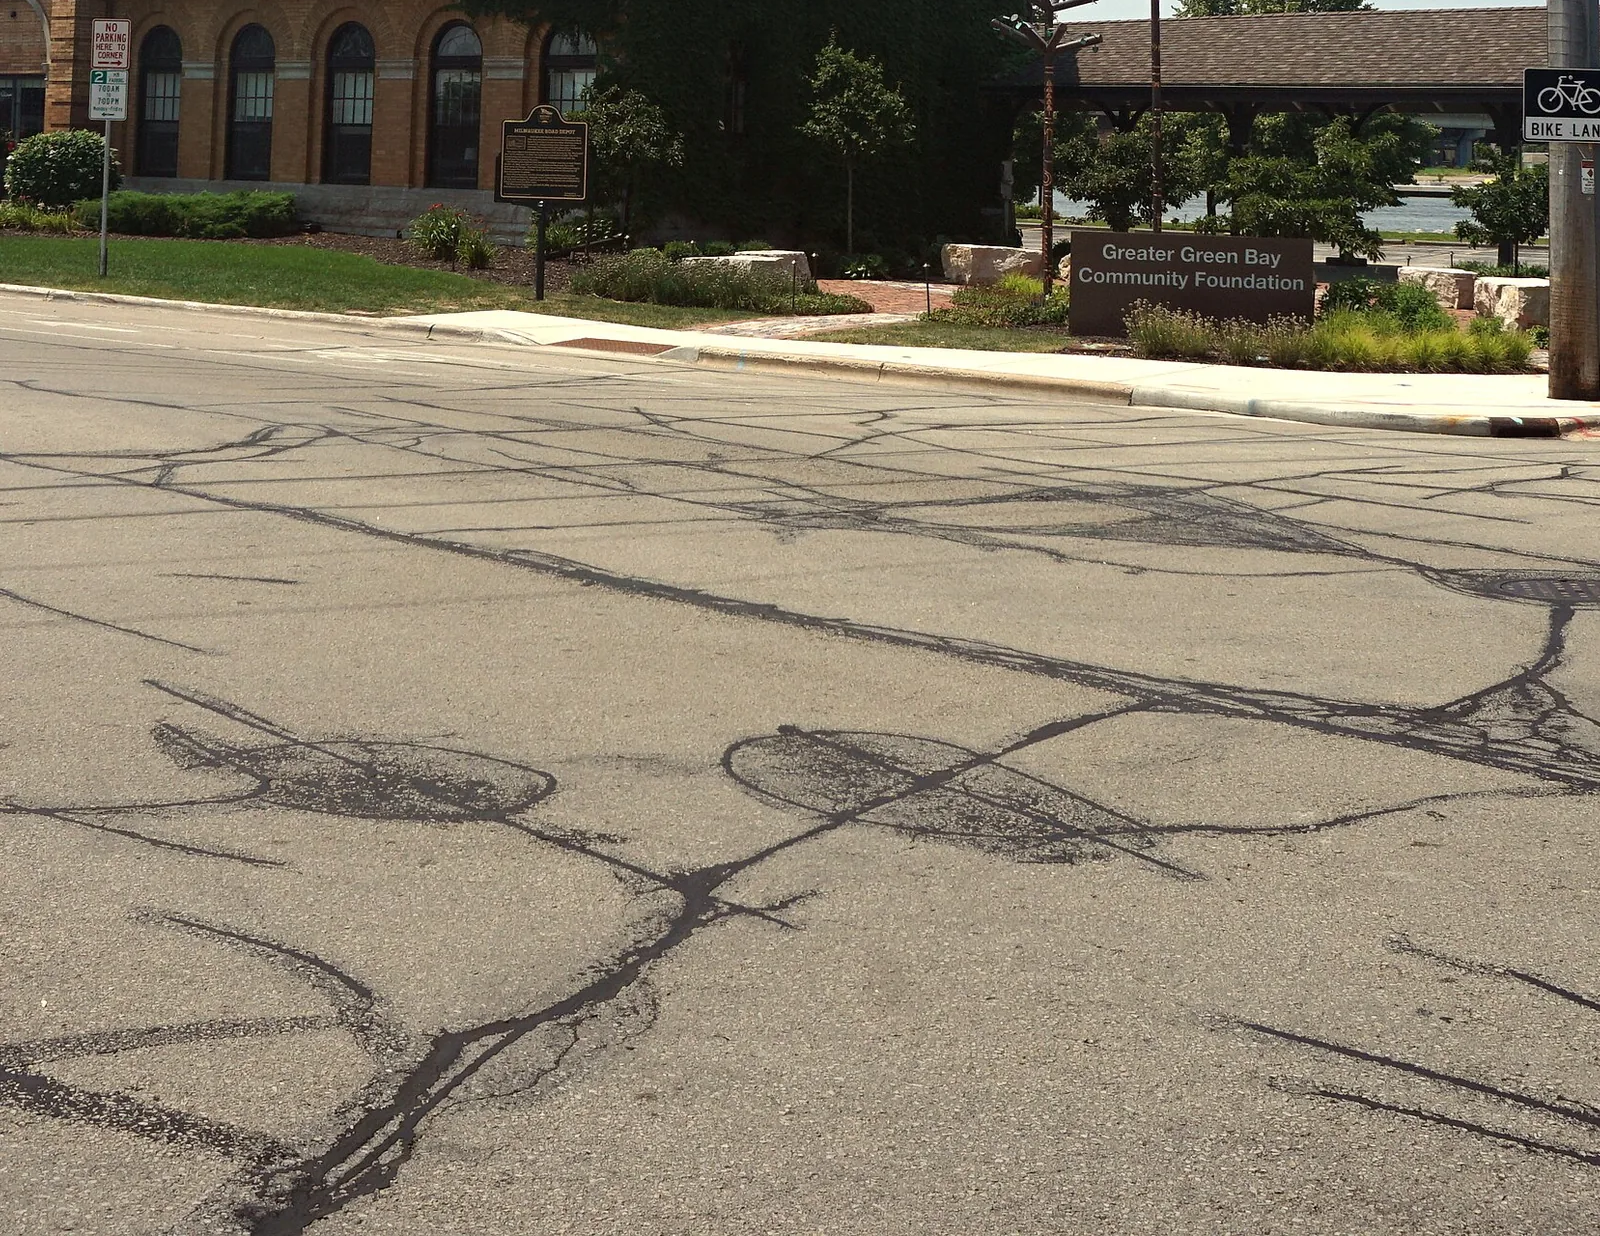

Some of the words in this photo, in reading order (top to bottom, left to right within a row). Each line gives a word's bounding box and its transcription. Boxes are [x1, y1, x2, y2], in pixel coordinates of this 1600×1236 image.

[105, 23, 118, 32] NO
[95, 33, 127, 42] PARKING
[95, 43, 113, 51] HERE
[97, 51, 123, 59] CORNER
[94, 71, 104, 83] 2
[1531, 122, 1563, 137] BIKE
[1572, 123, 1600, 138] LAN
[1102, 244, 1175, 262] Greater
[1180, 246, 1239, 264] Green
[1244, 249, 1281, 269] Bay
[1078, 267, 1189, 290] Community
[1194, 271, 1305, 291] Foundation
